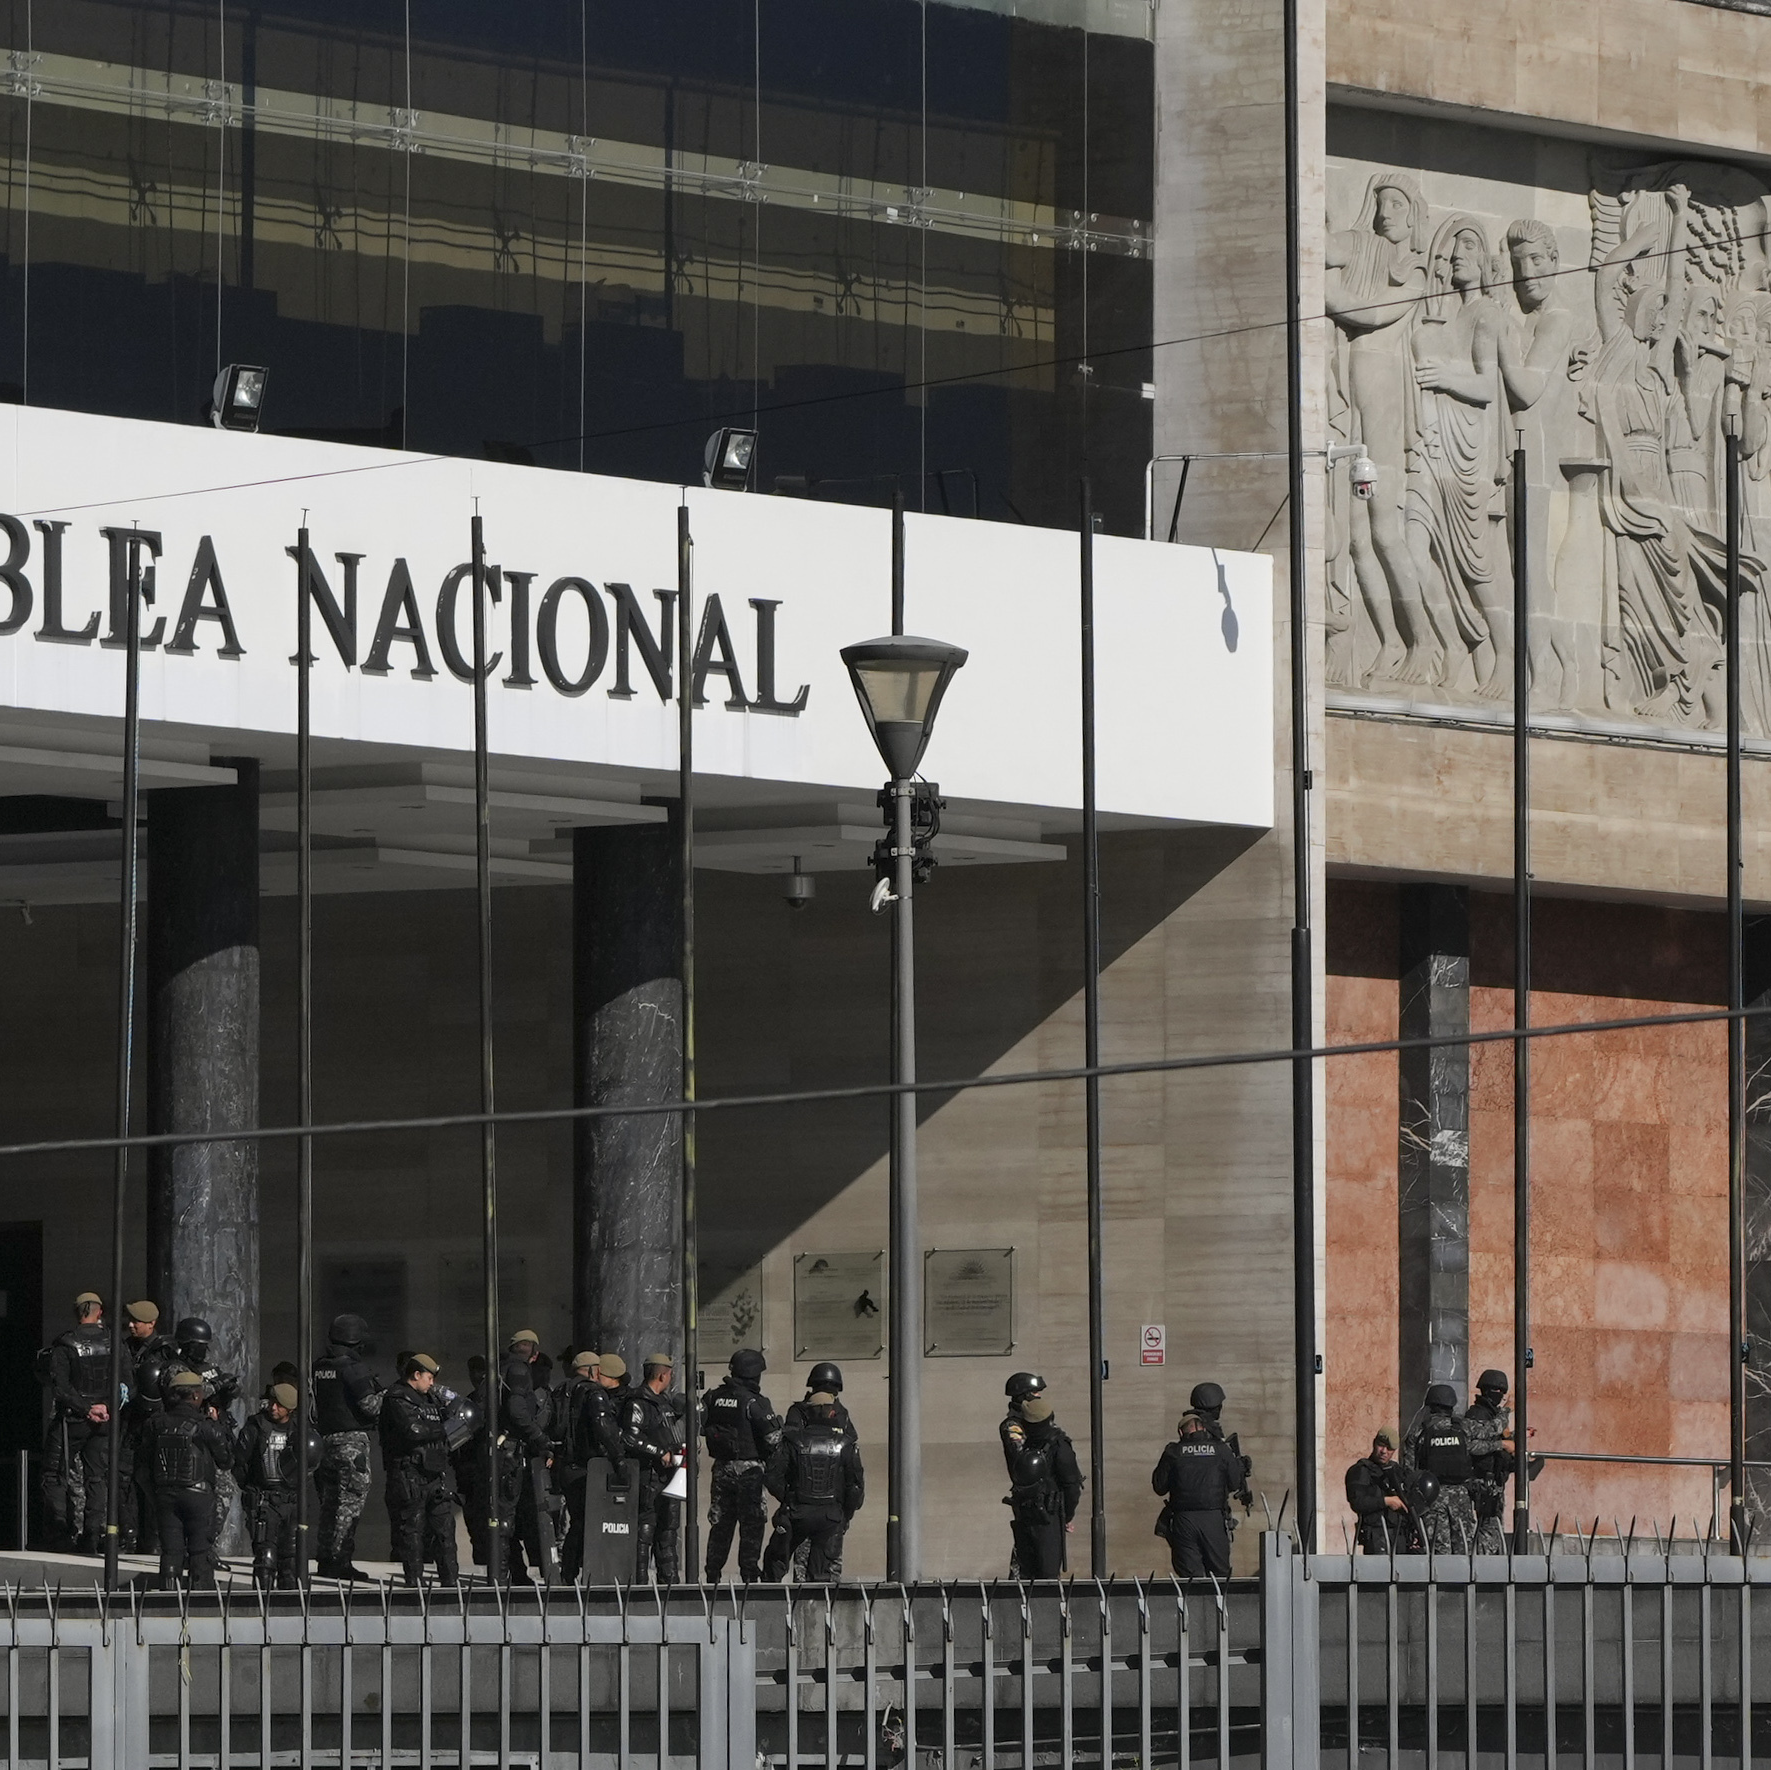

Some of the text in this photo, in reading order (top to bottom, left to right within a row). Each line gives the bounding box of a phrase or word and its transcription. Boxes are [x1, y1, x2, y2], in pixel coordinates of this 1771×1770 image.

[287, 544, 811, 716] NACIONAL
[714, 1398, 738, 1408] POLICIA
[1430, 1437, 1460, 1446] POLICIA
[1182, 1445, 1215, 1454] POLICIA
[602, 1522, 629, 1534] POLICIA
